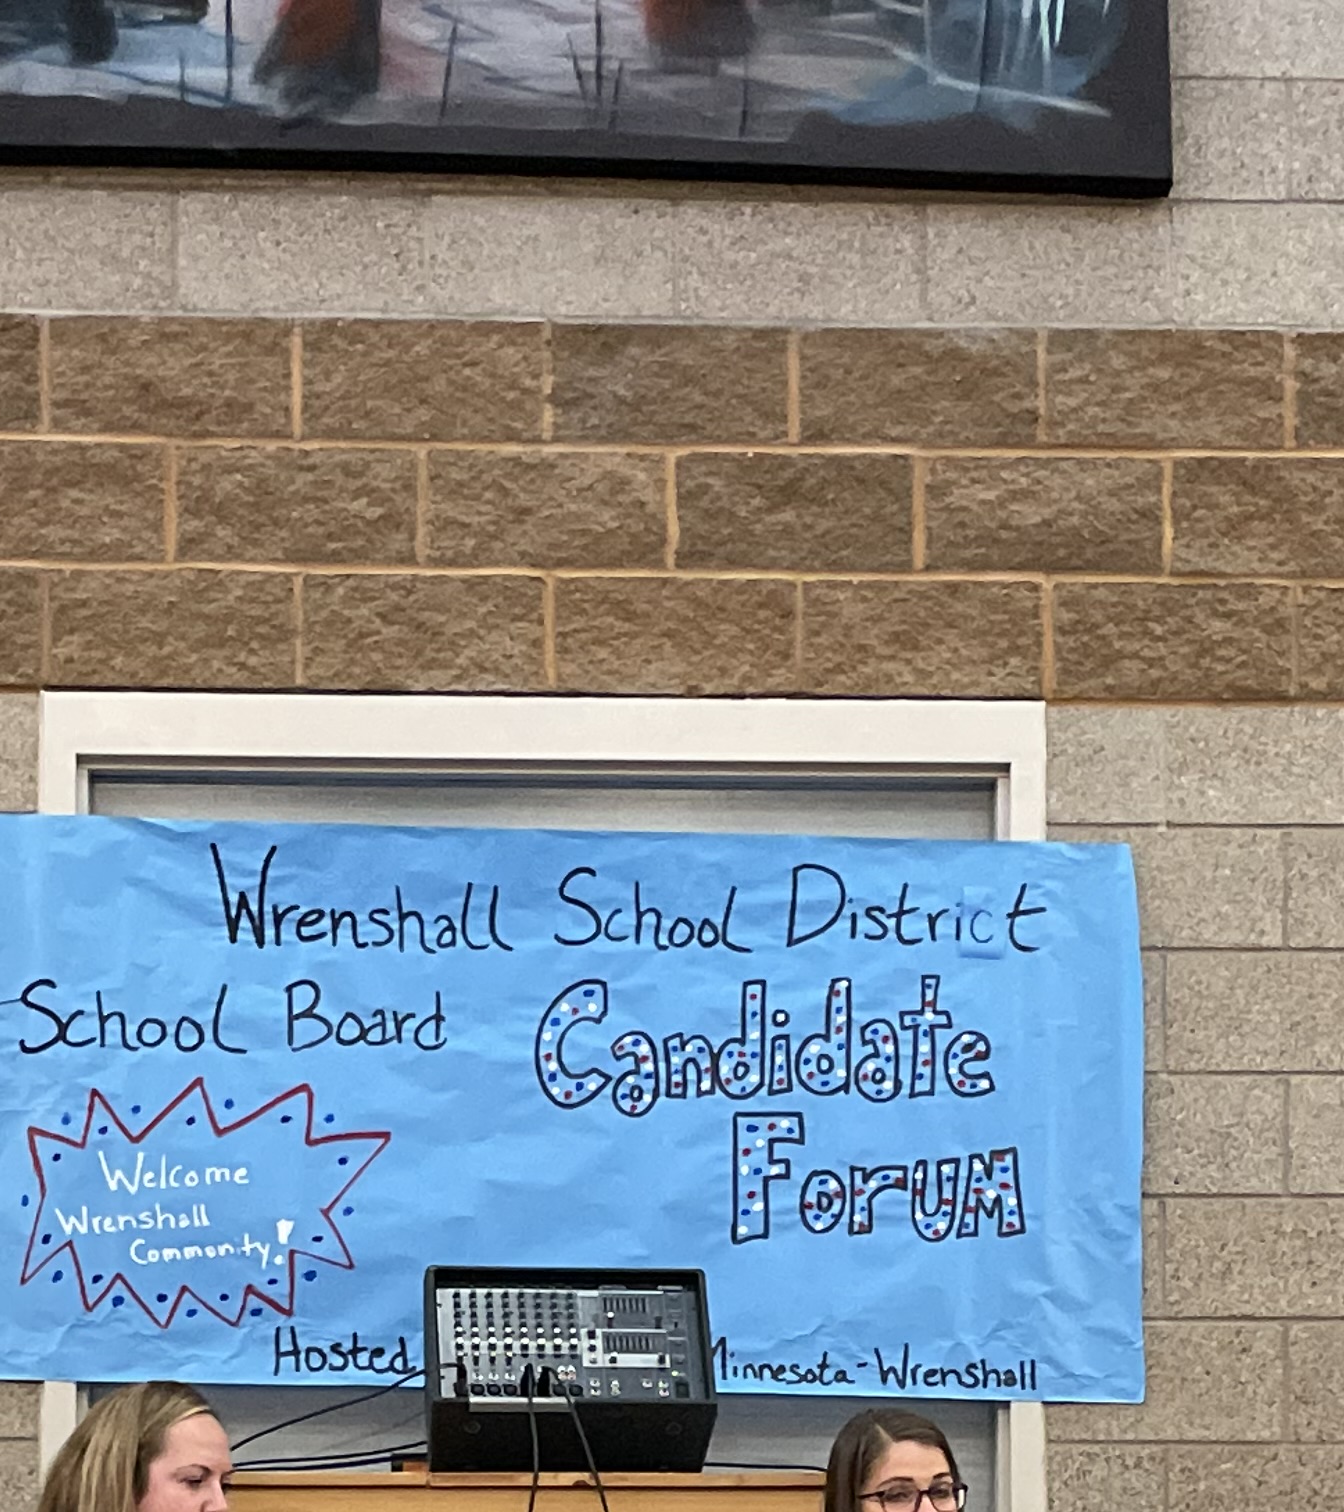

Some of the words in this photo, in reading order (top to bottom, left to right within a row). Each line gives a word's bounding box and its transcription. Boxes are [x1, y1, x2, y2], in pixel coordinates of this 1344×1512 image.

[211, 842, 514, 955] Wrenshall
[554, 866, 752, 953] School
[786, 863, 1048, 953] District
[19, 978, 249, 1055] School
[285, 979, 448, 1053] Board
[534, 973, 996, 1117] Candidate
[98, 1150, 250, 1195] Welcome
[55, 1203, 211, 1236] Wrenshall
[273, 1325, 417, 1376] Hosted
